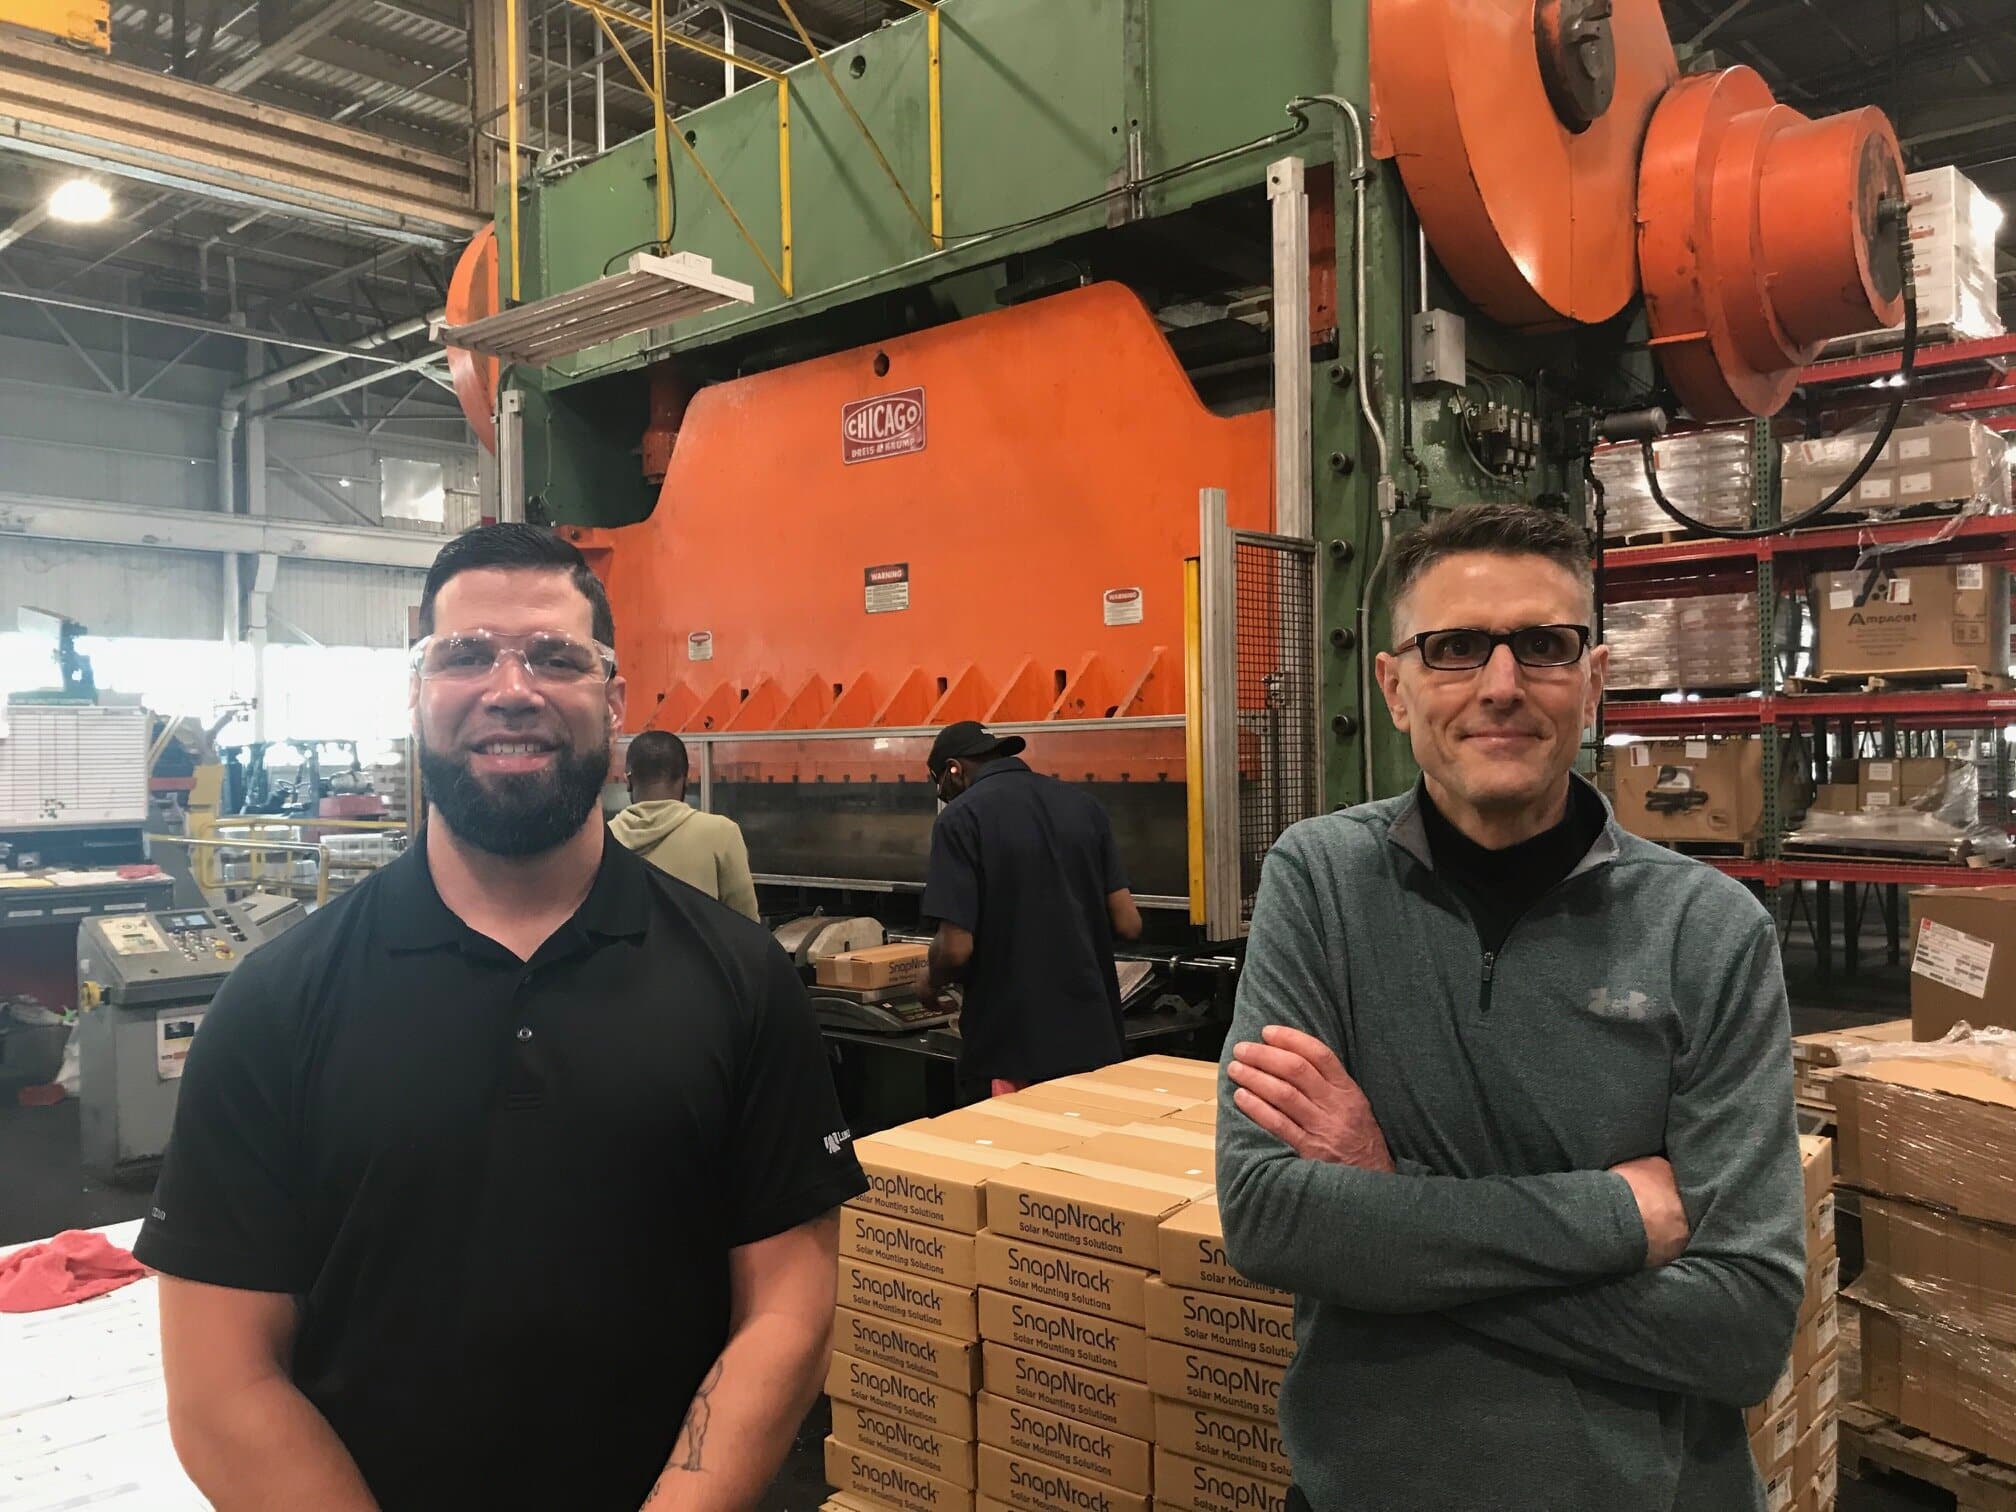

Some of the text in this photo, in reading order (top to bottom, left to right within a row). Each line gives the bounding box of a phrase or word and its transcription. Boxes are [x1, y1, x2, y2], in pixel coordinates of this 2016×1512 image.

[848, 403, 918, 438] CHICAGO
[866, 1174, 943, 1205] napNrack
[875, 1197, 908, 1213] Mounting
[910, 1206, 944, 1221] Solutions
[1019, 1193, 1121, 1237] SnapNrack
[855, 1218, 943, 1259] SnapNrack
[1019, 1222, 1122, 1254] Solar Mounting Solutions
[856, 1244, 944, 1274] Solar Mounting Solutions
[1008, 1248, 1110, 1294] SnapNrack
[1200, 1271, 1225, 1283] Solar
[852, 1269, 940, 1311] SnapNrack
[1008, 1276, 1111, 1310] Solar Mounting Solutions
[853, 1294, 942, 1326] Solar Mounting Solutions
[1012, 1305, 1116, 1352] SnapNrack
[1183, 1295, 1296, 1341] SnapNrac
[852, 1319, 936, 1363] SnapNrack
[1013, 1332, 1117, 1368] Solar Mounting Solutions
[1184, 1326, 1294, 1359] Solar Mounting Solutio
[851, 1363, 936, 1408] SnapNrack
[1015, 1357, 1116, 1408] SnapNrack
[1187, 1385, 1211, 1399] Solar
[1214, 1392, 1259, 1414] Mounting
[1016, 1385, 1117, 1424] Solar Mounting Solutions
[857, 1409, 940, 1457] SnapNrack
[1010, 1408, 1111, 1459] SnapNrack
[1010, 1436, 1111, 1476] Solar Mounting Solutions
[1195, 1441, 1218, 1455] Solar
[1222, 1448, 1267, 1471] Mounting
[851, 1455, 936, 1504] SnapNrack
[1010, 1462, 1110, 1512] SnapNrack
[1010, 1490, 1030, 1503] Solar
